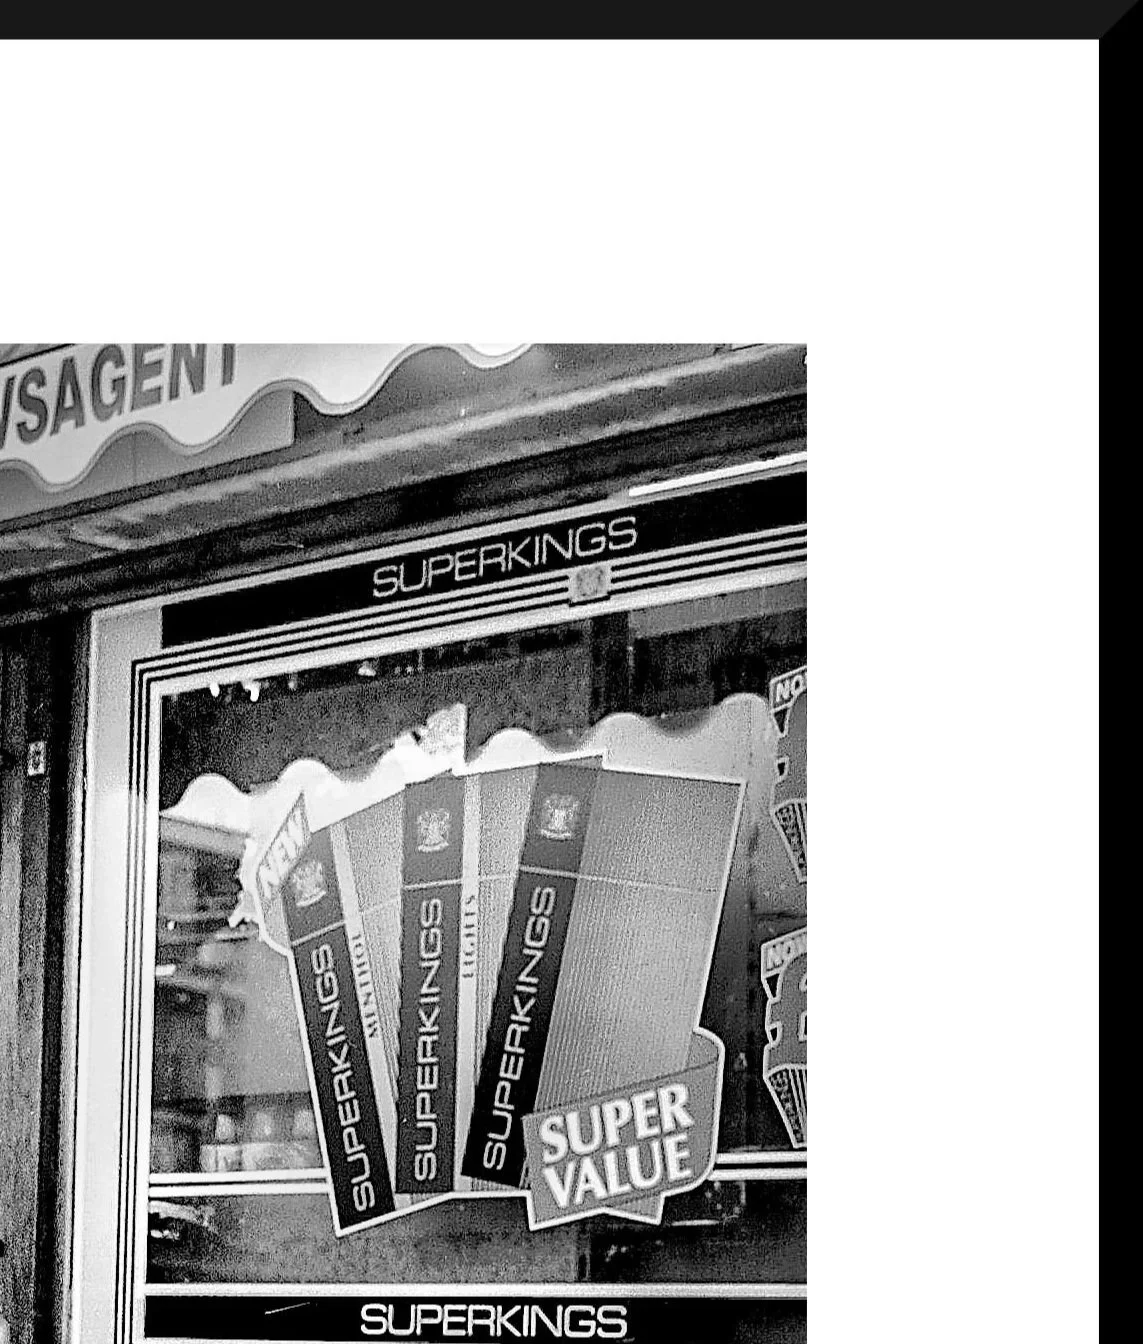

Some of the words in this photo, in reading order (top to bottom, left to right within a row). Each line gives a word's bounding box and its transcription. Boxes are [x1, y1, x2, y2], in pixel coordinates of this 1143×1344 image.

[372, 517, 638, 598] SUPERKINGS
[461, 893, 477, 979] LIGHTS
[413, 898, 444, 1182] SUPERKINGS
[482, 885, 557, 1171] SUPERKINGS
[311, 944, 376, 1212] SUPERKINGS
[540, 1081, 695, 1163] SUPER
[542, 1133, 694, 1208] VALUE
[360, 1303, 629, 1339] SUPERKINGS
